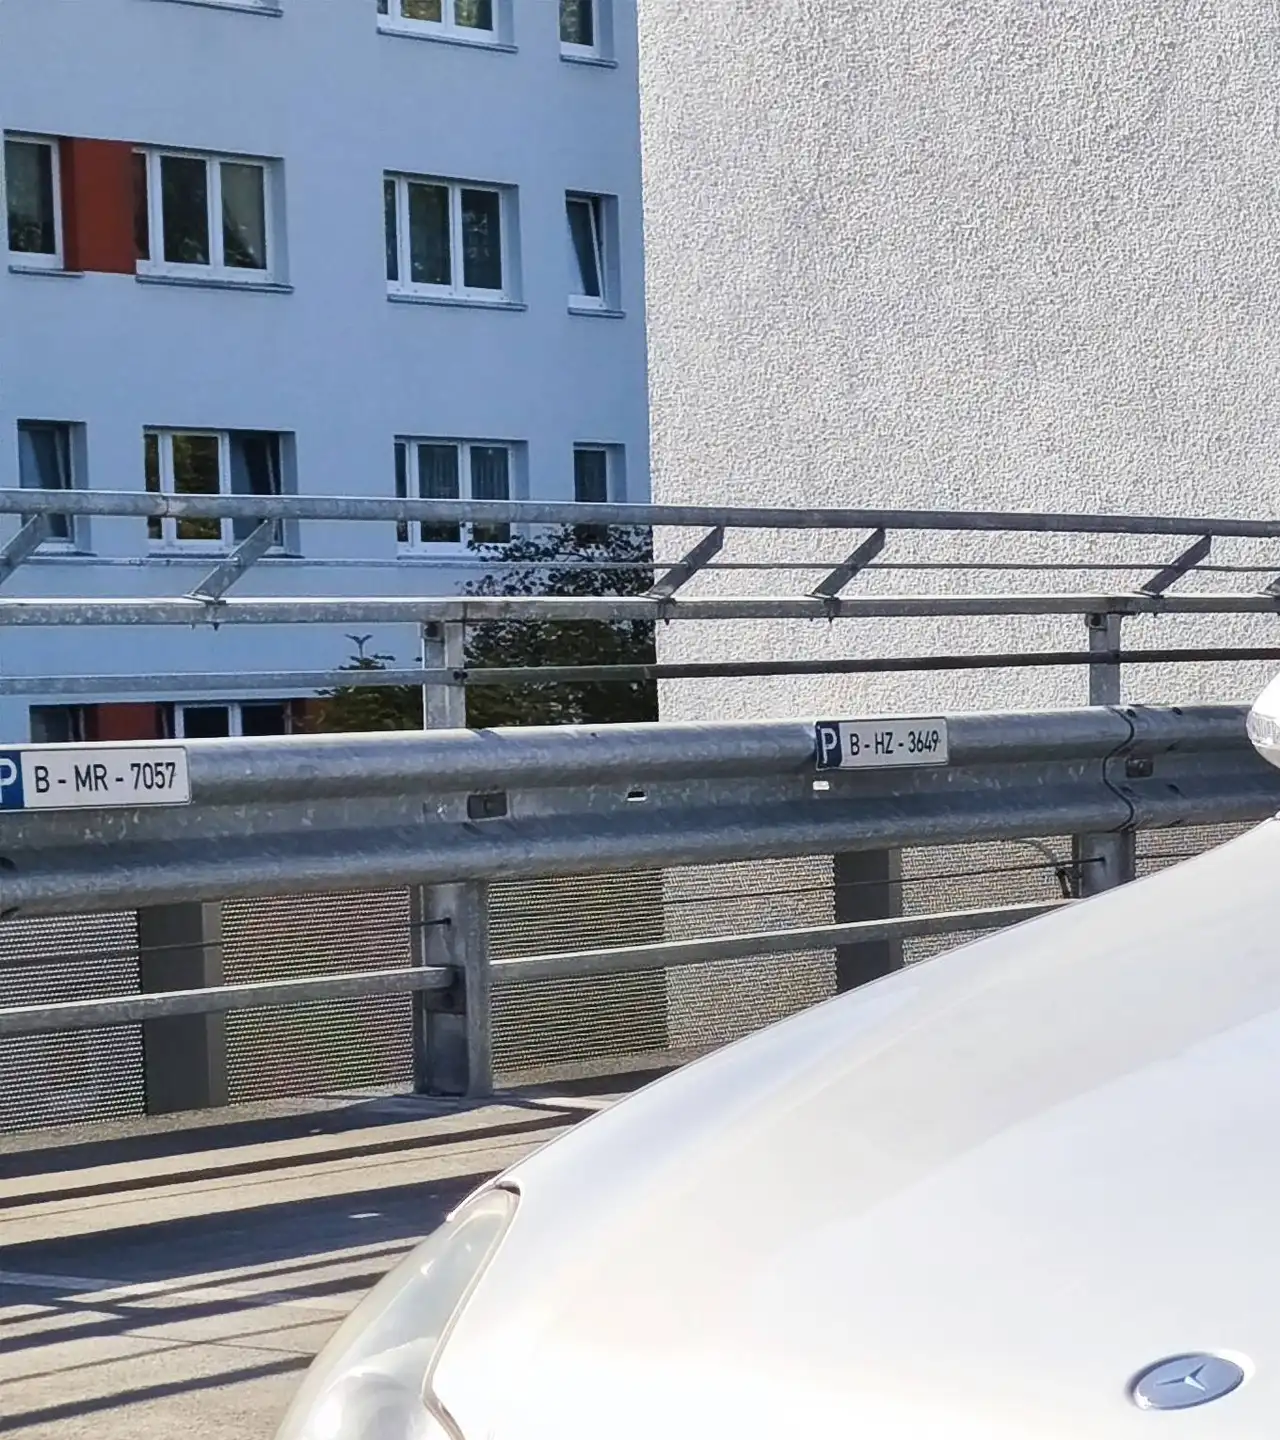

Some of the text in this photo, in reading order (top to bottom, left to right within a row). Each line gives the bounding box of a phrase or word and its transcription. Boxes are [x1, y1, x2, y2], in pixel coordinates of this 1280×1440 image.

[821, 728, 838, 764] P
[874, 731, 894, 755] HZ
[907, 729, 939, 753] 3649
[73, 763, 109, 792] MR
[130, 761, 176, 790] 7057
